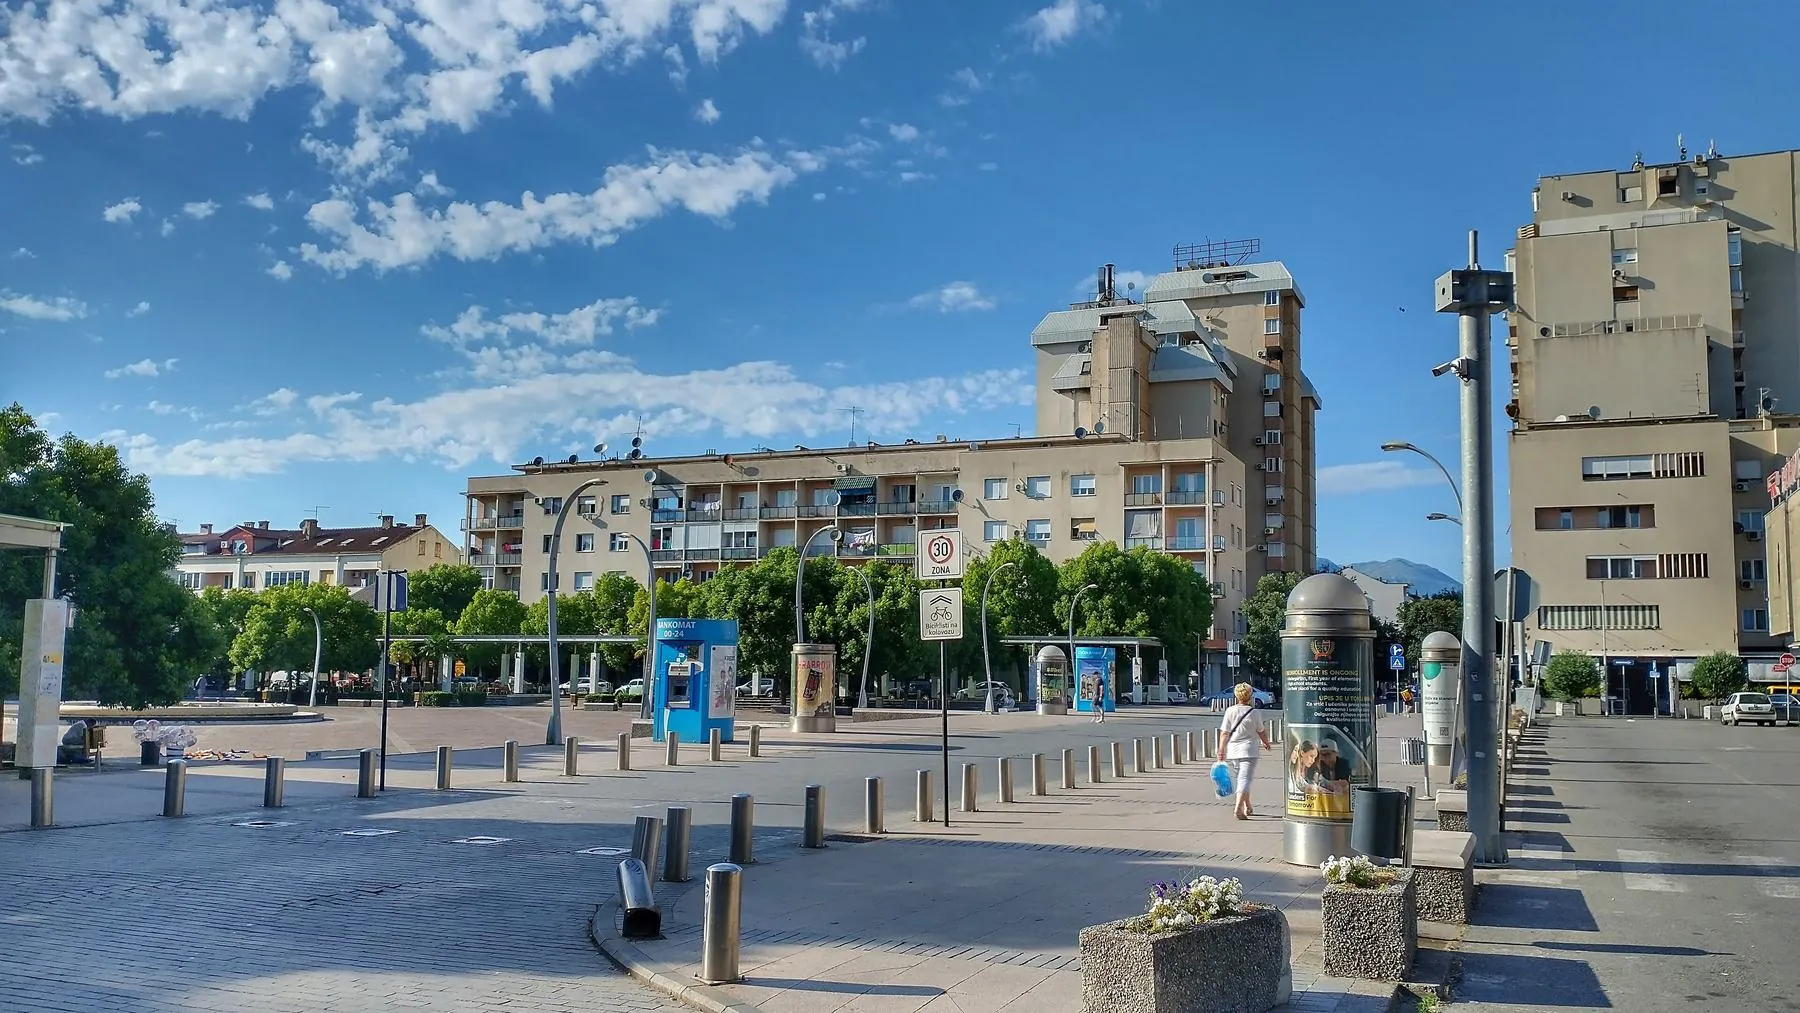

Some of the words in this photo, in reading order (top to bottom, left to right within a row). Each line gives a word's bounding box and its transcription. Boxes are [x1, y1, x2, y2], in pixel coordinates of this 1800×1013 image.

[933, 542, 948, 557] 30
[931, 566, 951, 574] ZONA
[663, 630, 685, 638] 00-24
